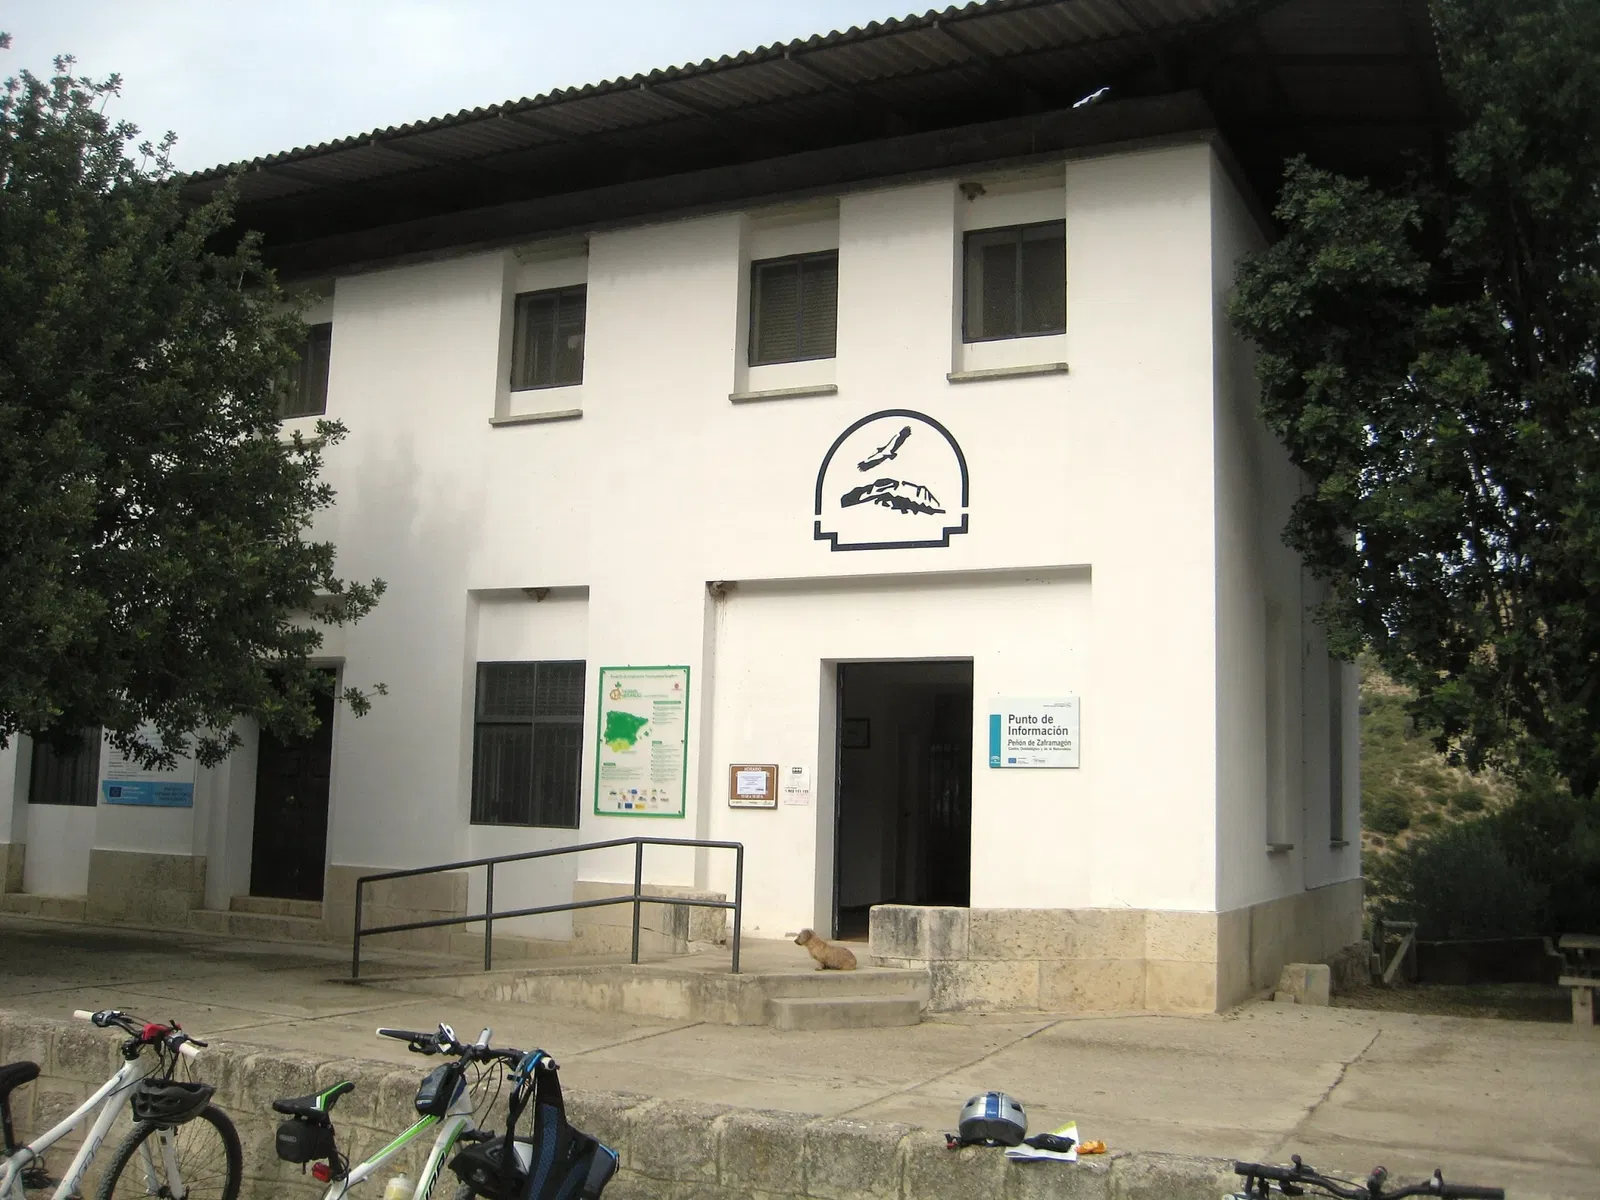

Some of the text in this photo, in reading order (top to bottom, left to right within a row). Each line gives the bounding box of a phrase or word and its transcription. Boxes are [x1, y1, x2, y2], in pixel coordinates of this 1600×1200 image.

[1008, 714, 1054, 724] Punto de
[1008, 725, 1069, 735] Información
[1008, 739, 1026, 747] Peñón
[1037, 739, 1072, 747] Zaframagón
